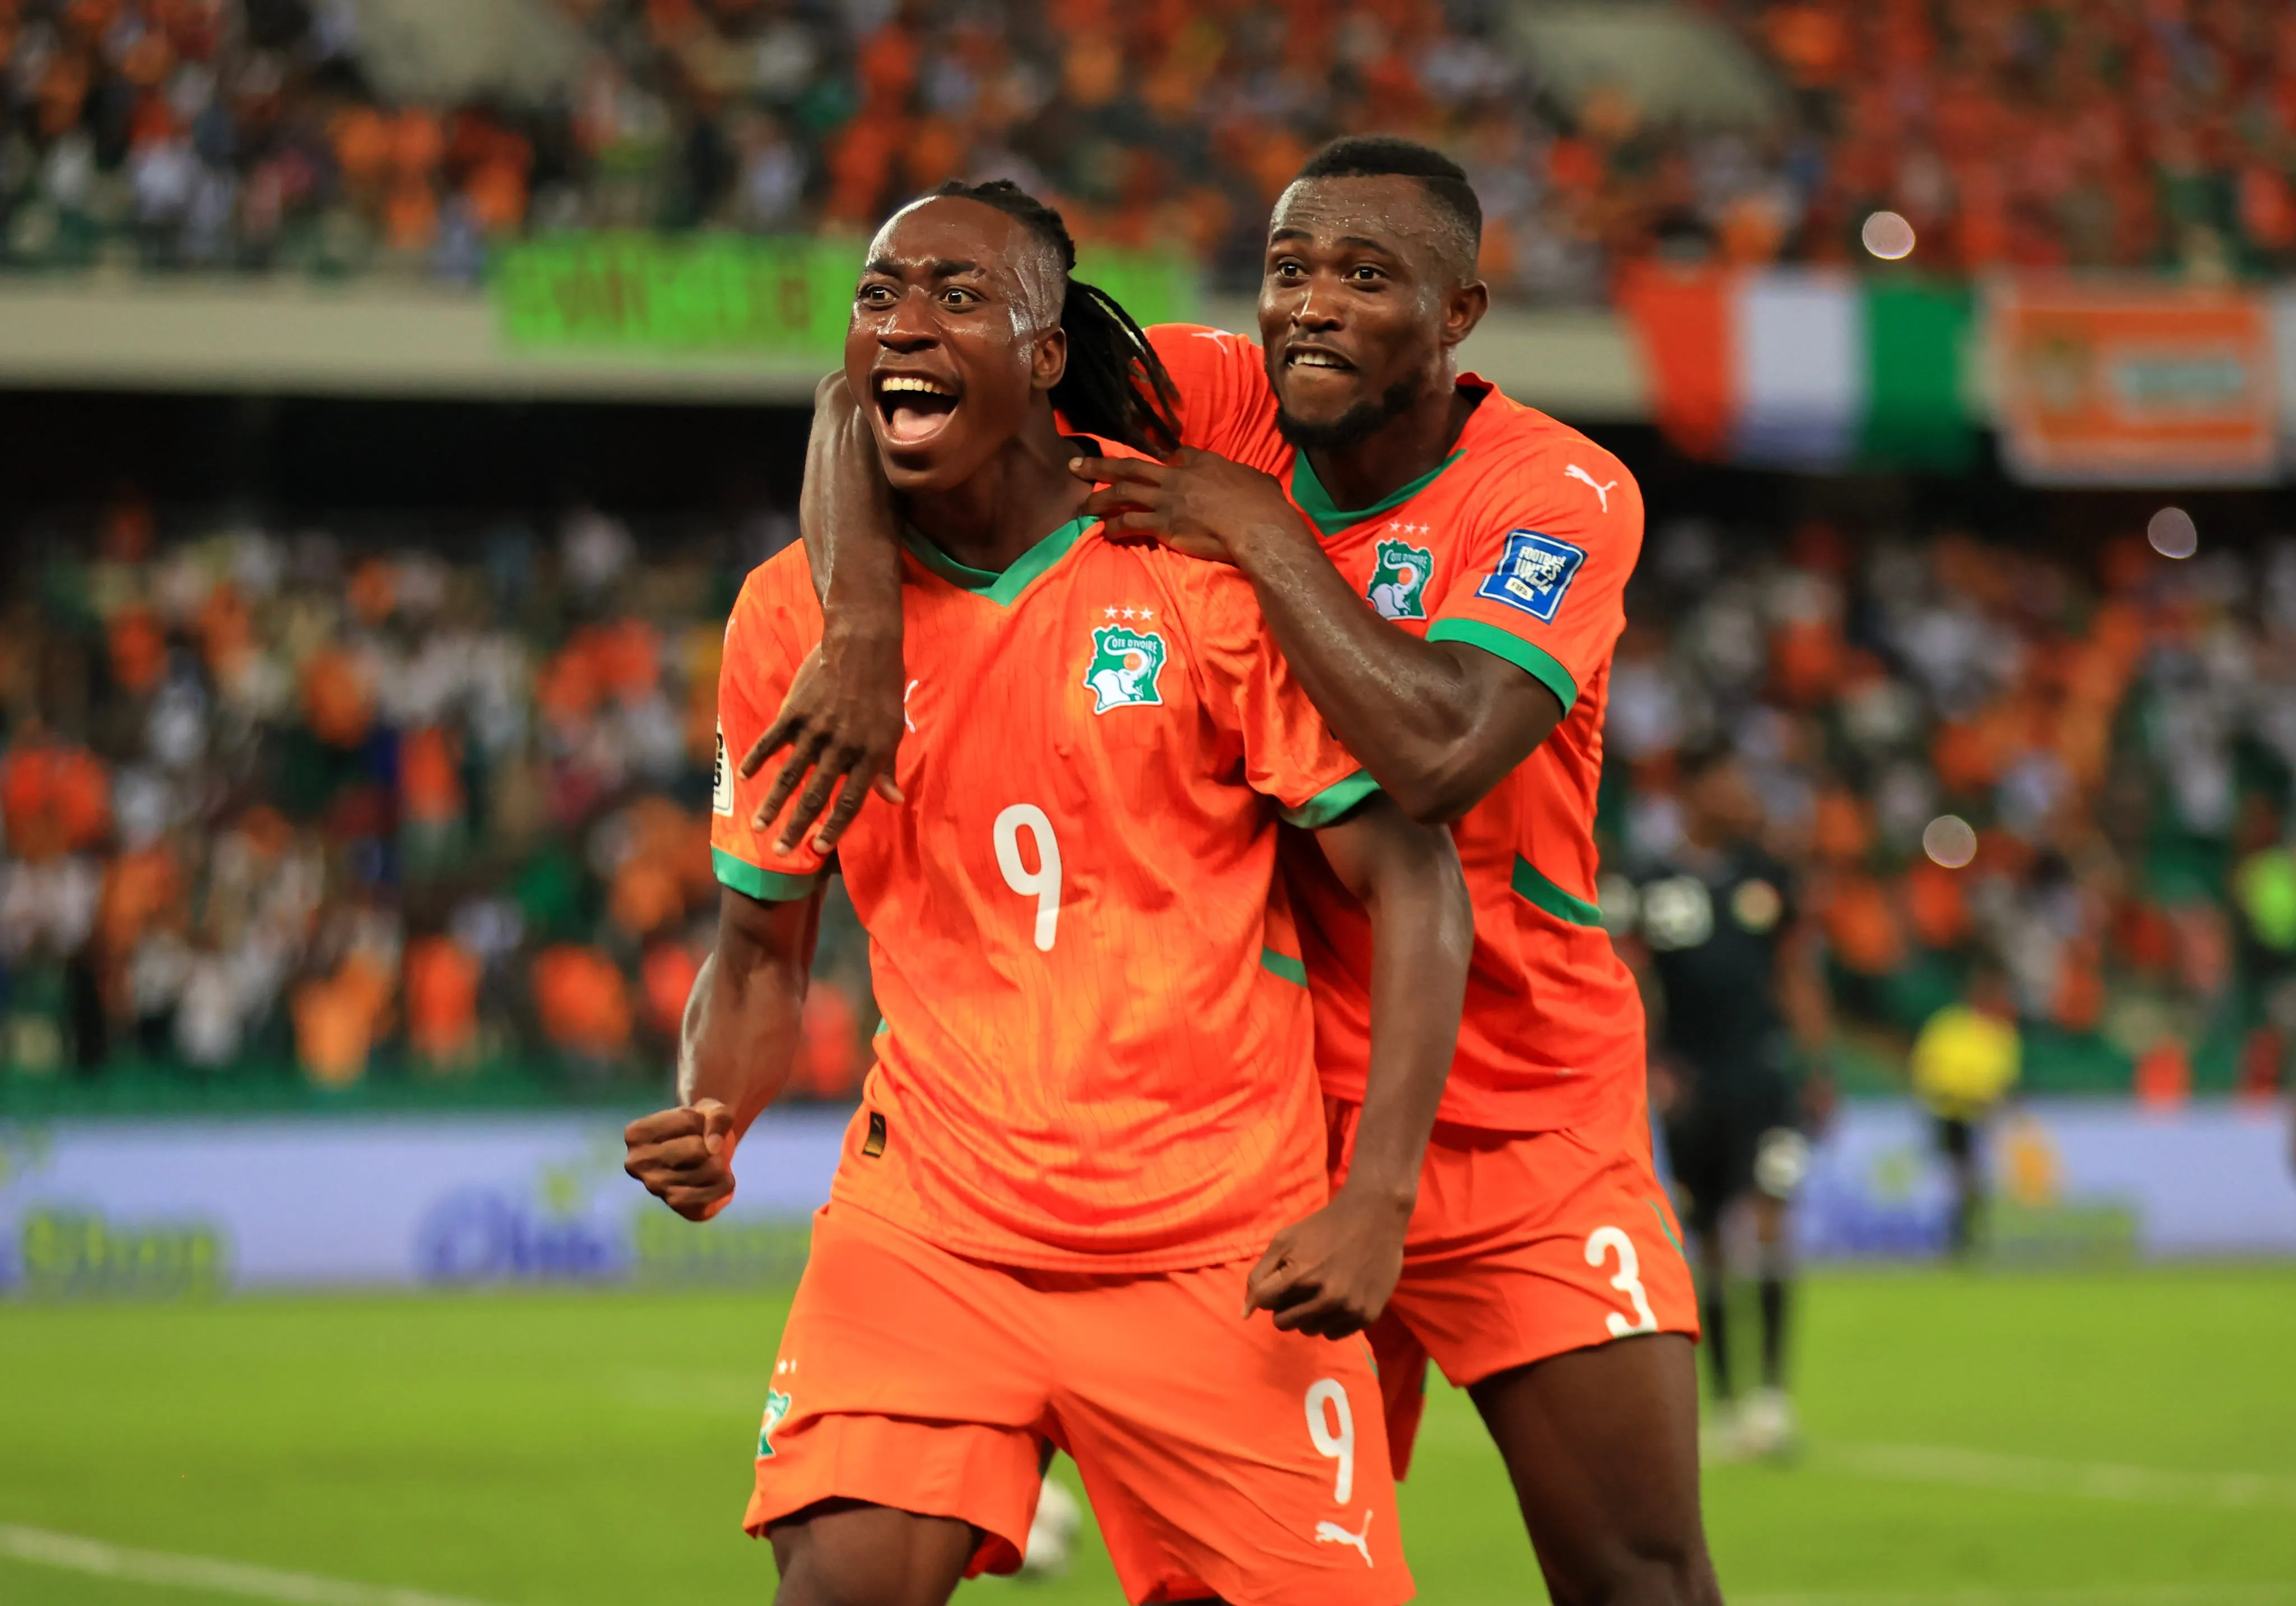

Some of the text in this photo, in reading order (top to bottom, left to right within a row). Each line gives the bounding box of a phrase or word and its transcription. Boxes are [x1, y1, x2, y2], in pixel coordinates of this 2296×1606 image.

[993, 803, 1063, 952] 9
[1584, 1226, 1658, 1339] 3
[1305, 1378, 1355, 1505] 9
